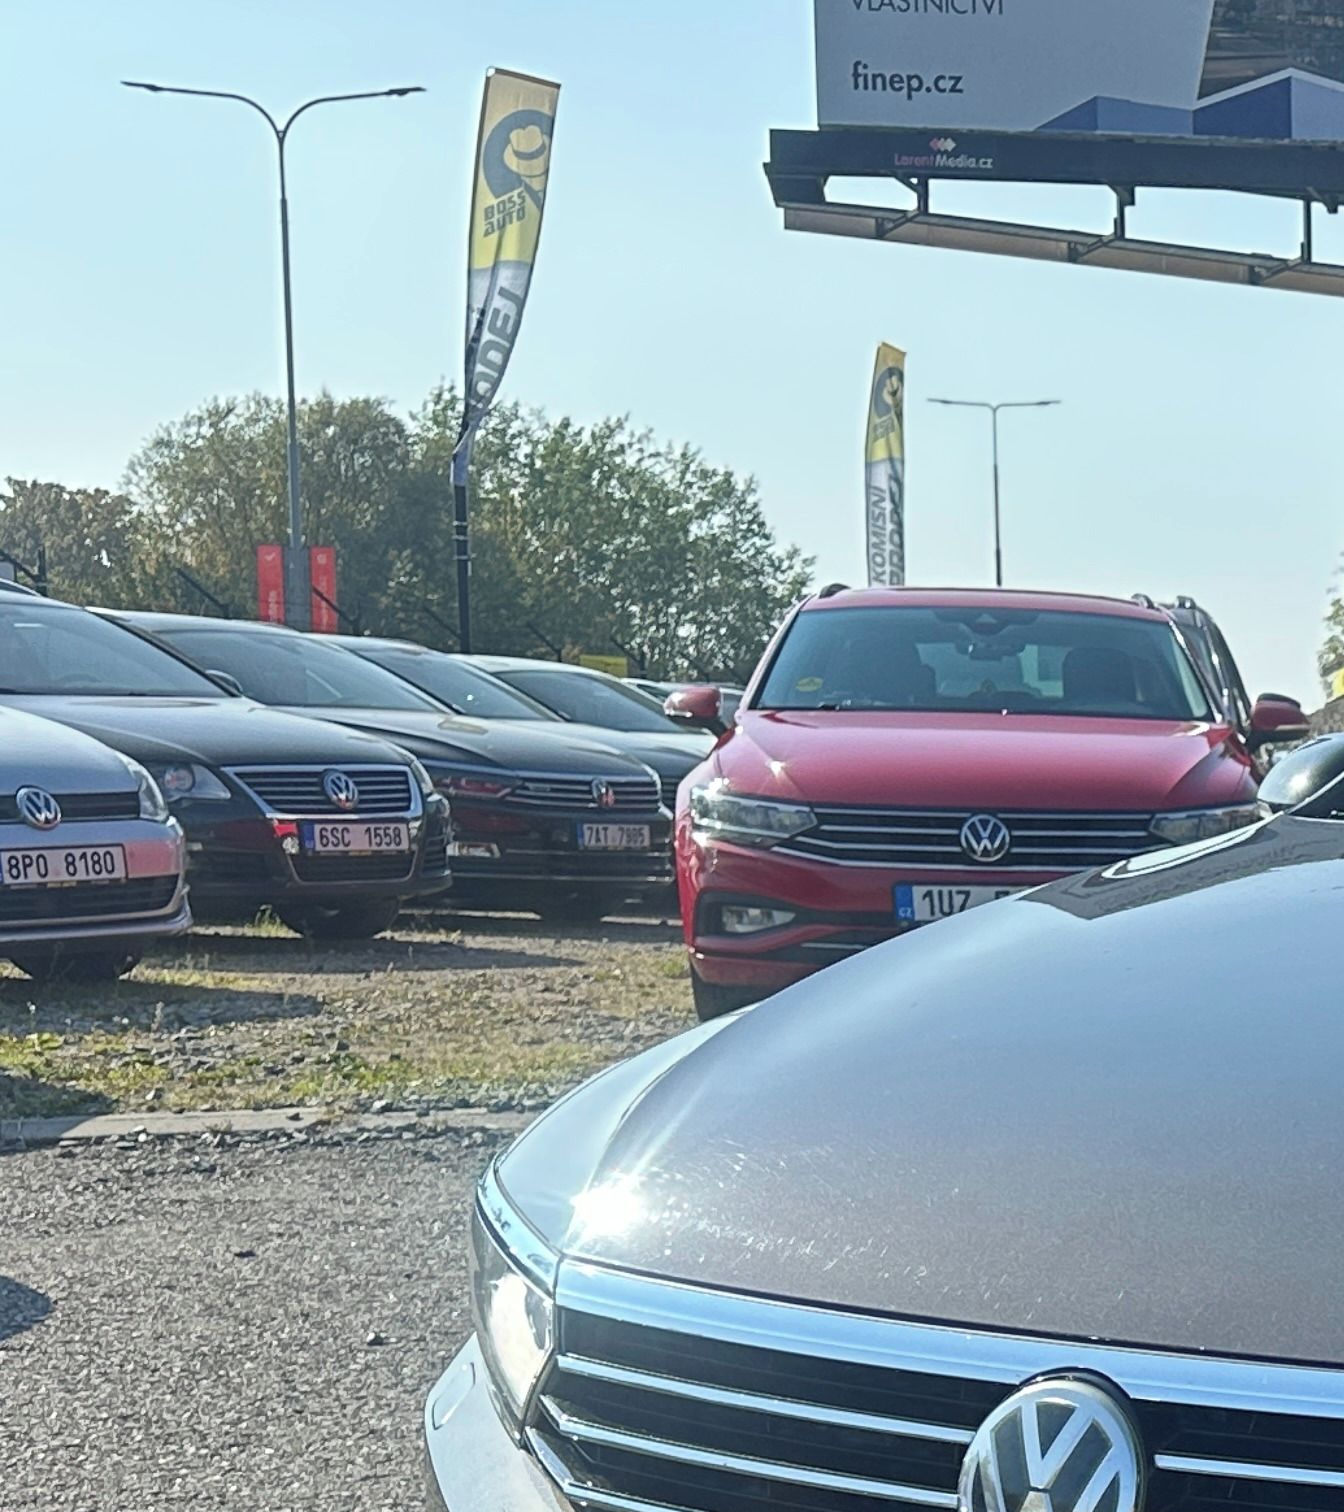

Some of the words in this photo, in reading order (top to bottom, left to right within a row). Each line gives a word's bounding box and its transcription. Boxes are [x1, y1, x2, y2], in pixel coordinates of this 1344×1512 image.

[852, 60, 965, 101] finep.cz
[483, 204, 526, 238] AUTO
[484, 189, 526, 222] BOSS
[319, 826, 351, 848] 6SC
[364, 826, 402, 847] 1558
[64, 850, 115, 877] 8180
